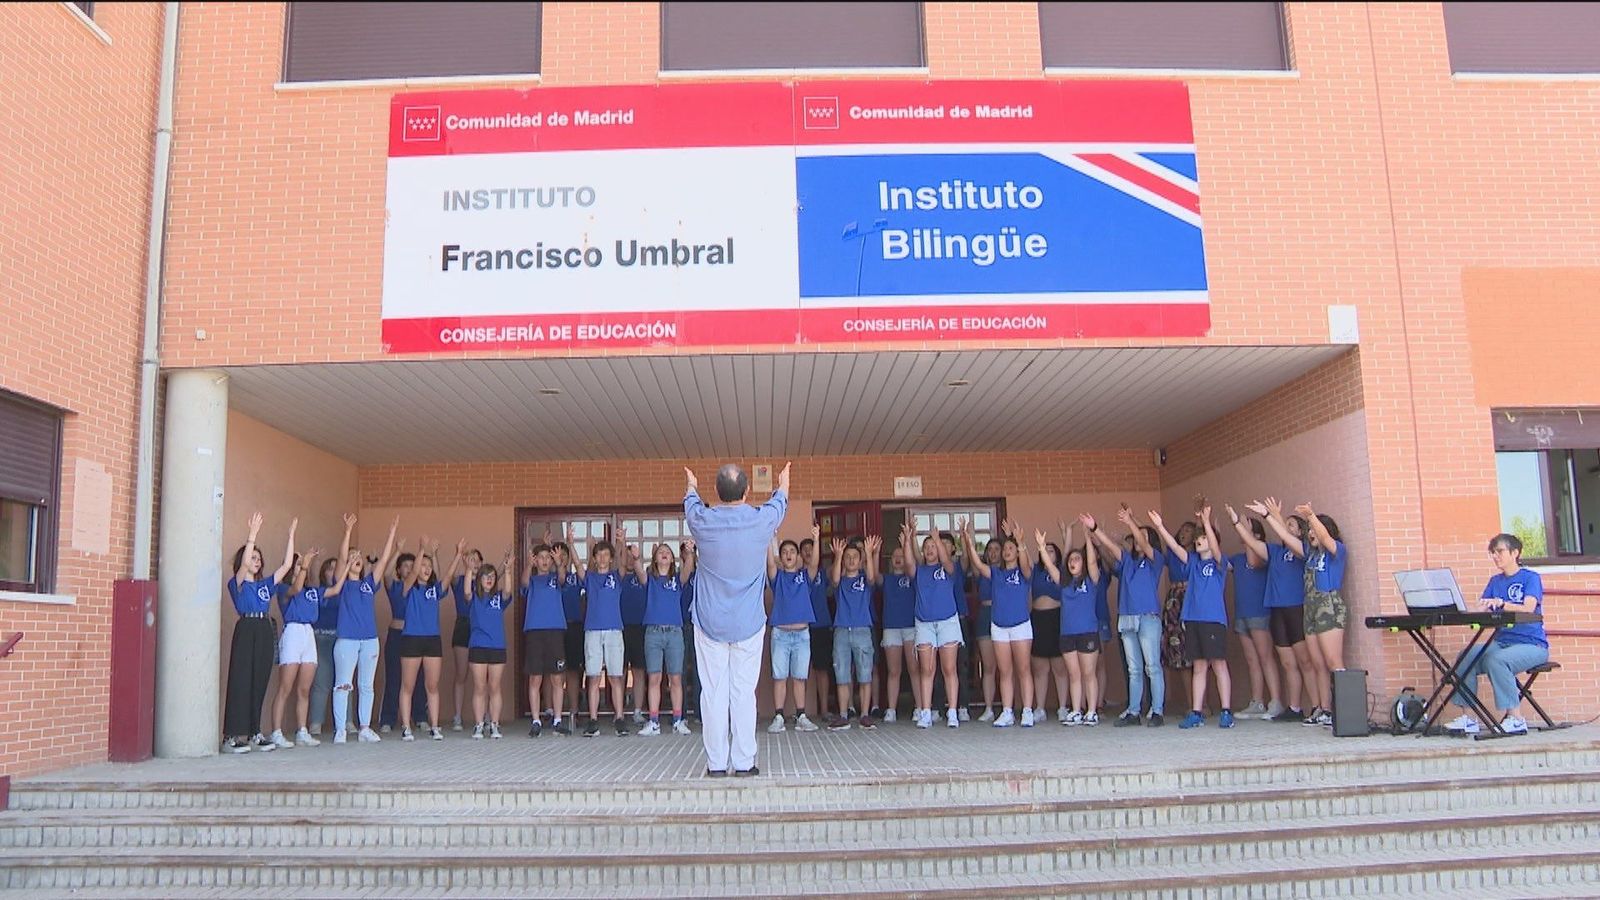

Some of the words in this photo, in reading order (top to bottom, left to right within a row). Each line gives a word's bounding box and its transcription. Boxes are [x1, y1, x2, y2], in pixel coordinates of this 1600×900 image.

[445, 112, 542, 130] Comunidad
[547, 111, 568, 126] de
[574, 109, 634, 125] Madrid
[849, 105, 945, 120] Comunidad
[949, 105, 970, 118] de
[975, 105, 1033, 118] Madrid
[442, 186, 596, 212] INSTITUTO
[878, 180, 1043, 211] Instituto
[441, 241, 603, 272] Francisco
[615, 237, 735, 267] Umbral
[881, 227, 1048, 266] Bilingüe
[440, 322, 545, 343] CONSEJERÍA
[549, 325, 572, 340] DE
[577, 319, 677, 339] EDUCACIÓN
[843, 316, 934, 332] CONSEJERÍA
[938, 317, 958, 330] DE
[962, 314, 1047, 330] EDUCACIÓN
